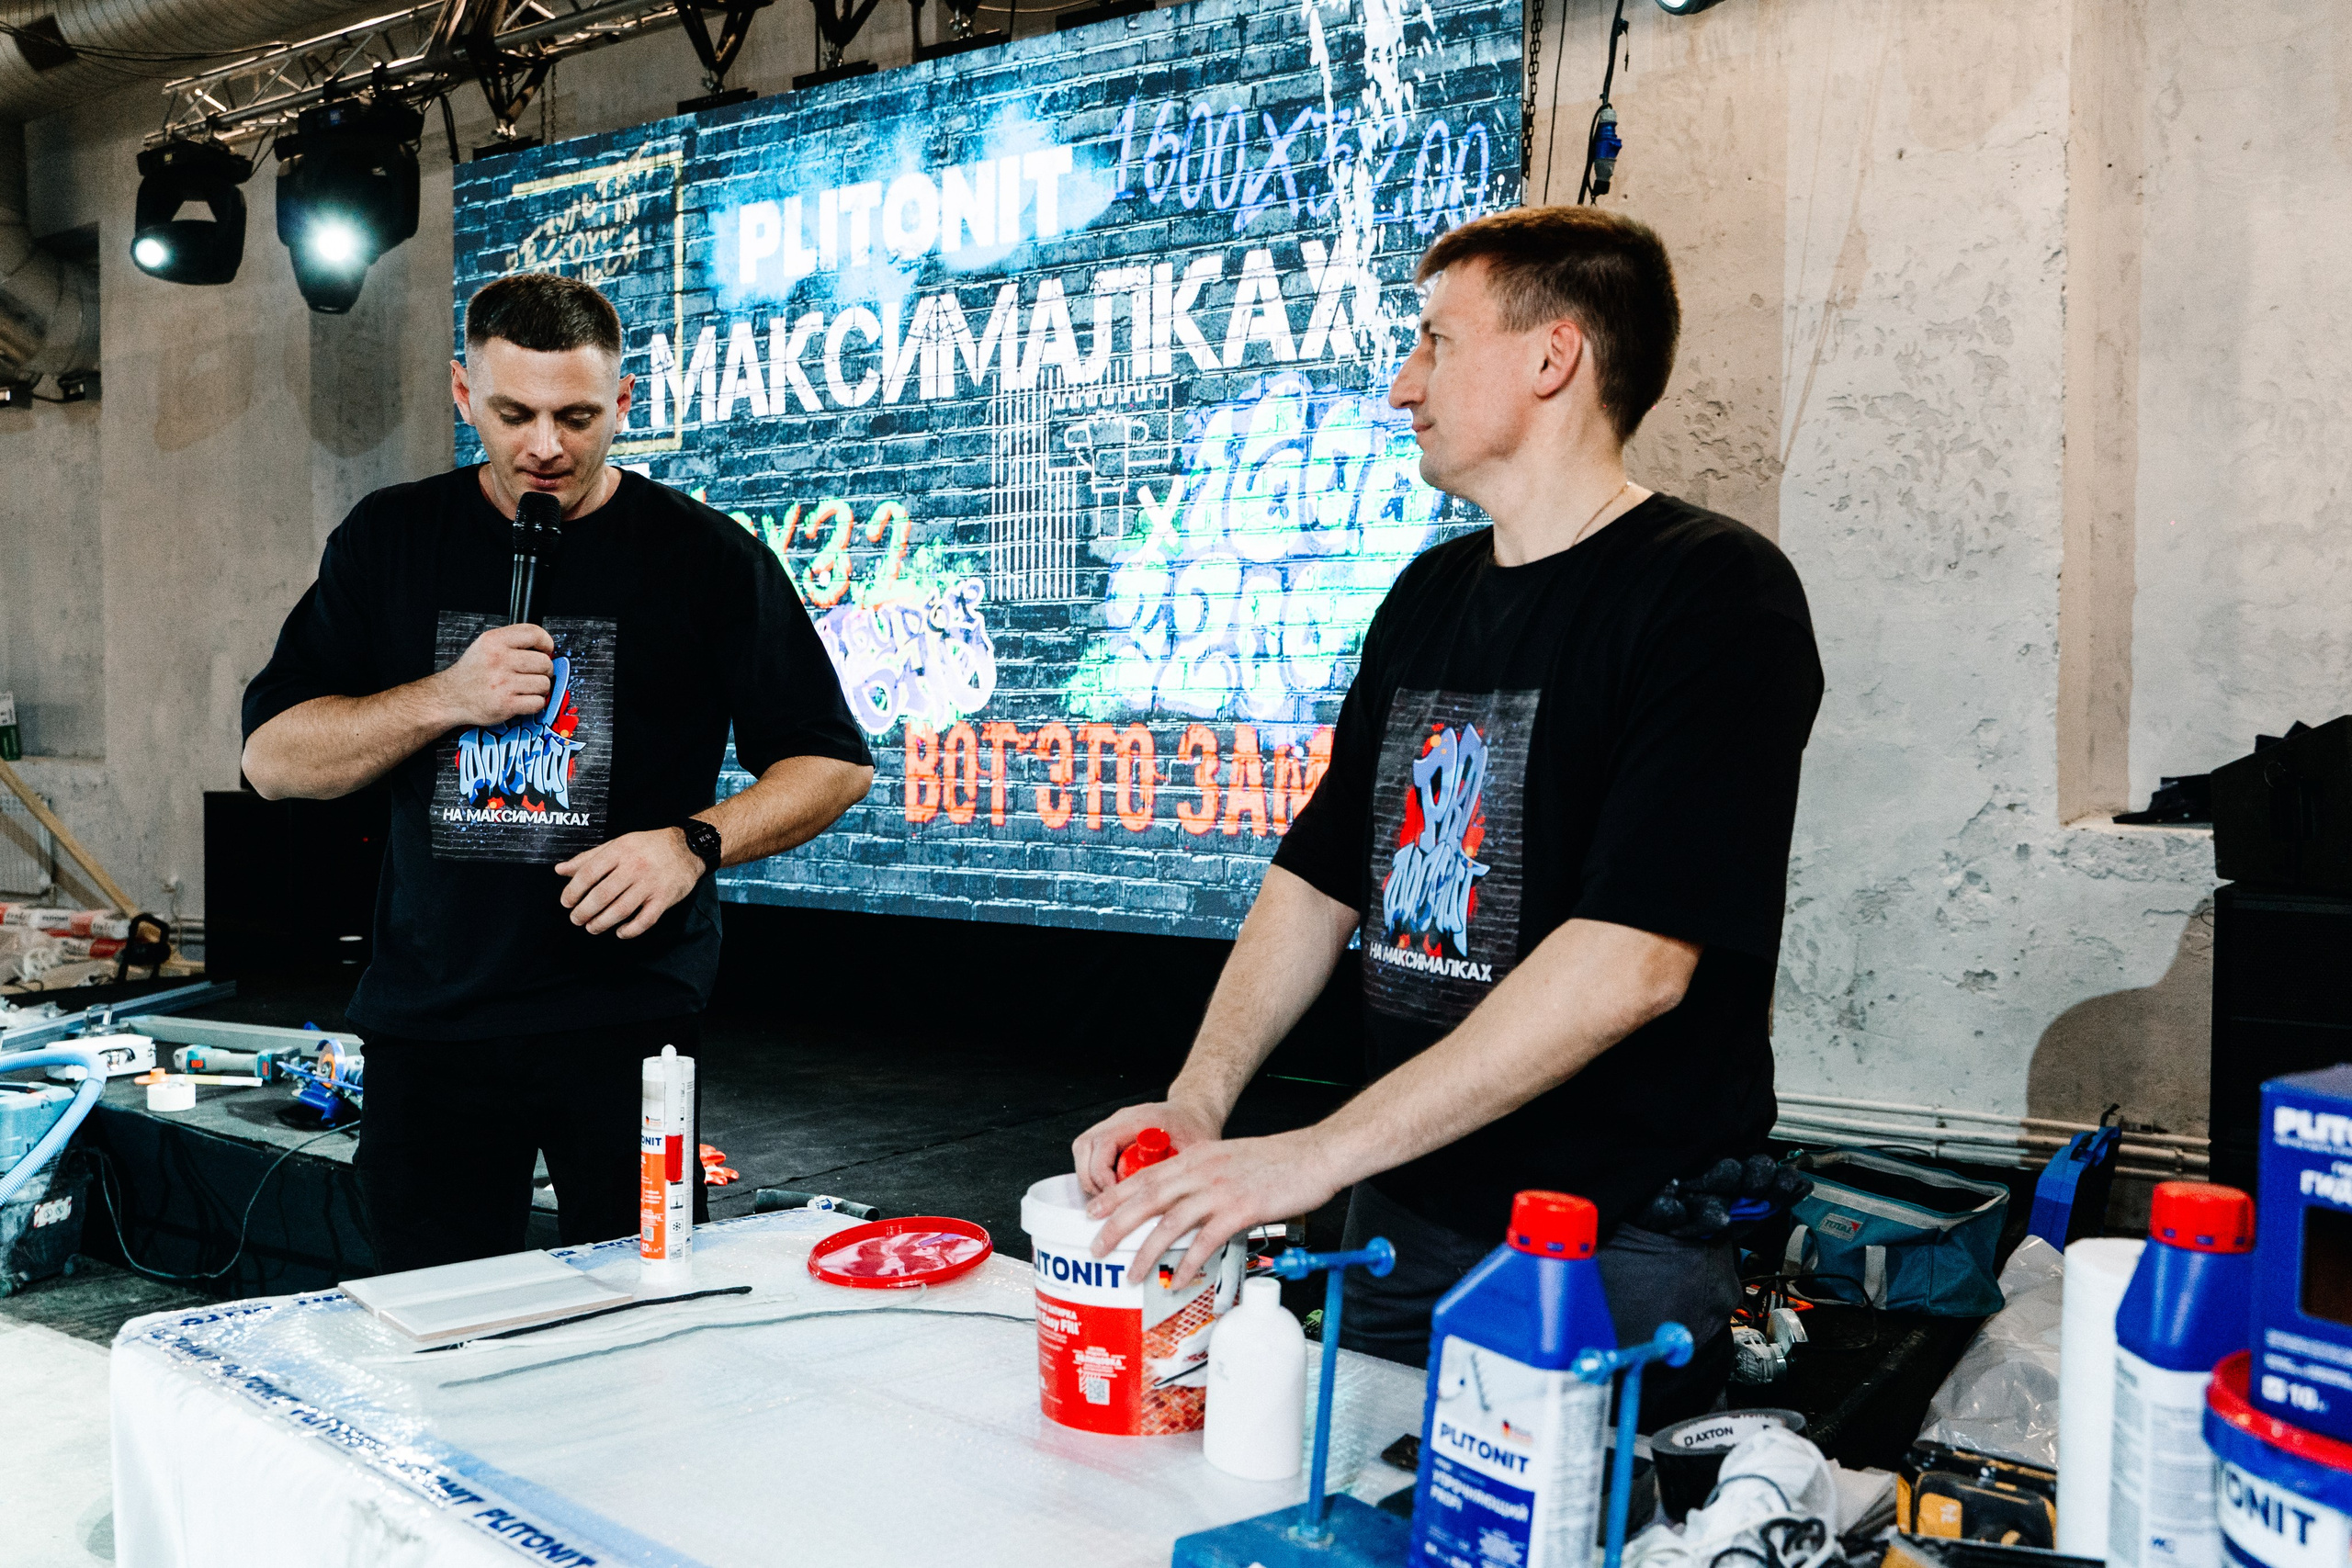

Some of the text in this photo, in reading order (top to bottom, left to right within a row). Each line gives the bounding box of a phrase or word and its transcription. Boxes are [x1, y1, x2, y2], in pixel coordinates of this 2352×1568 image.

[739, 145, 1073, 285] PLITONIT
[649, 239, 1362, 428] МАКСИМАЛКАХ
[904, 720, 1011, 827] ВОТ
[1031, 722, 1165, 832] ЭТО
[443, 808, 591, 827] НА МАКСИМАЛКАХ
[1369, 941, 1493, 983] НА МАКСИМАЛКАХ
[1035, 1248, 1125, 1289] ITONIT
[1440, 1422, 1531, 1473] PLITONIT
[473, 1507, 598, 1568] PLITONIT
[2225, 1469, 2316, 1546] ONIT
